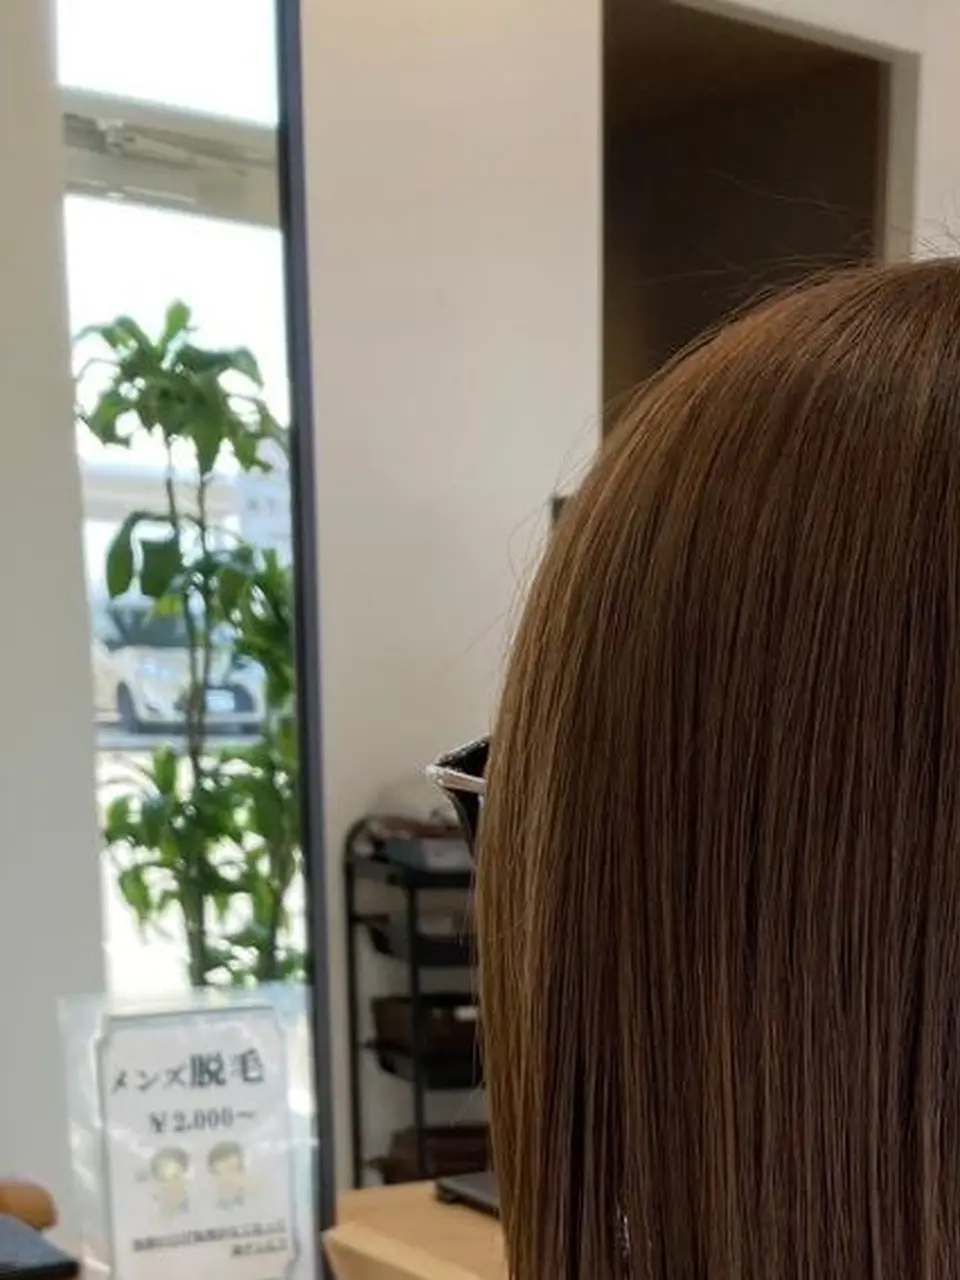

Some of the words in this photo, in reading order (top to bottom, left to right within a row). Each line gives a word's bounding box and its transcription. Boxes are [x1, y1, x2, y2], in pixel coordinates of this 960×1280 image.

[111, 1048, 264, 1092] メンズ脱毛
